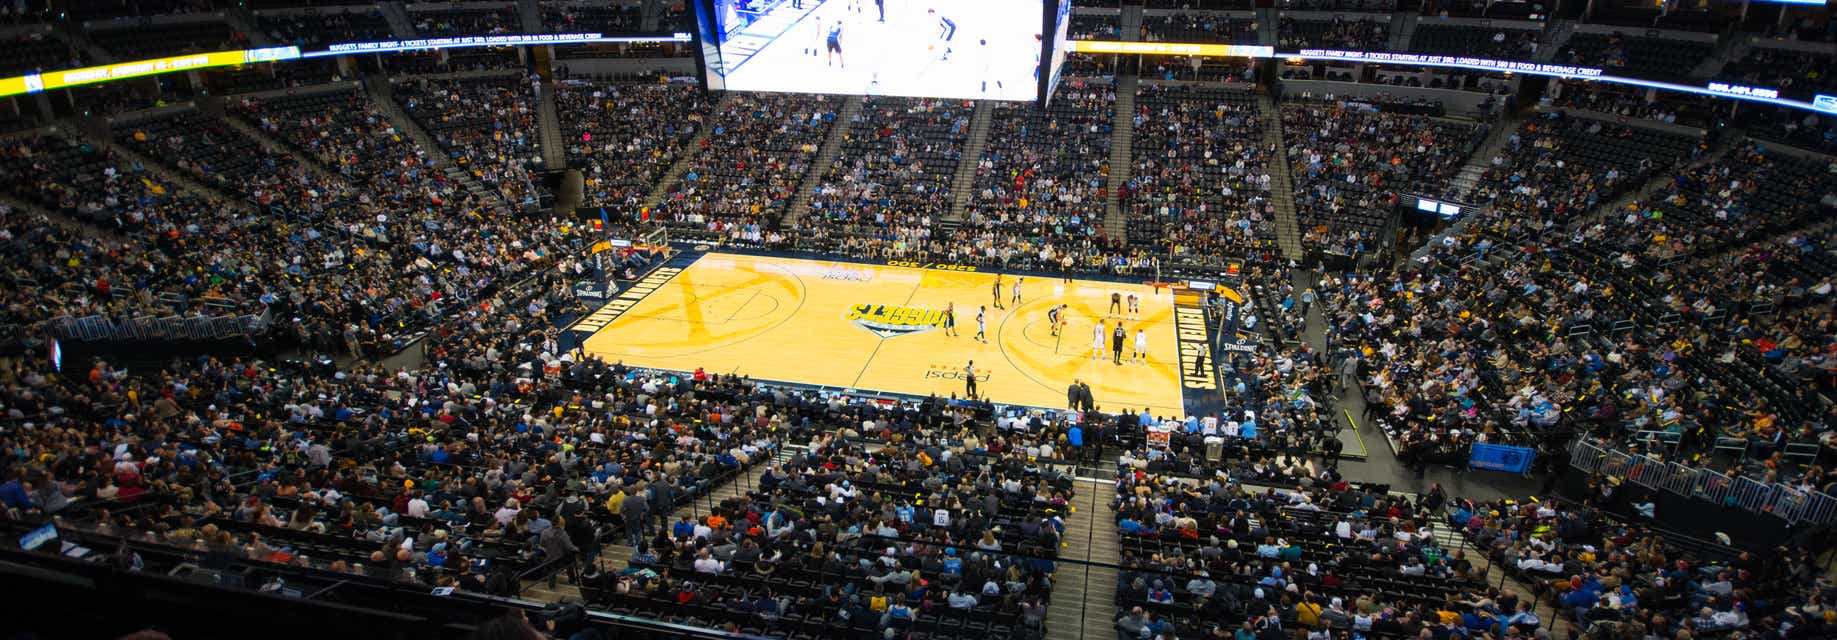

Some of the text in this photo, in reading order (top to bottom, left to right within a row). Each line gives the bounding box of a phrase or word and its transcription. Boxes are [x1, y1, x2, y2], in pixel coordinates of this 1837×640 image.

[1300, 49, 1325, 57] NUGGETS
[1369, 52, 1391, 60] TICKETS
[1391, 53, 1419, 61] STARTING
[1456, 57, 1480, 65] LOADED
[1517, 62, 1535, 70] FOOD
[1543, 65, 1577, 74] BEVERAGE
[1577, 68, 1603, 76] CREDIT
[571, 267, 682, 332] DENVER NUGGETS
[1176, 307, 1208, 340] DENVER
[1224, 343, 1257, 353] SPALDING
